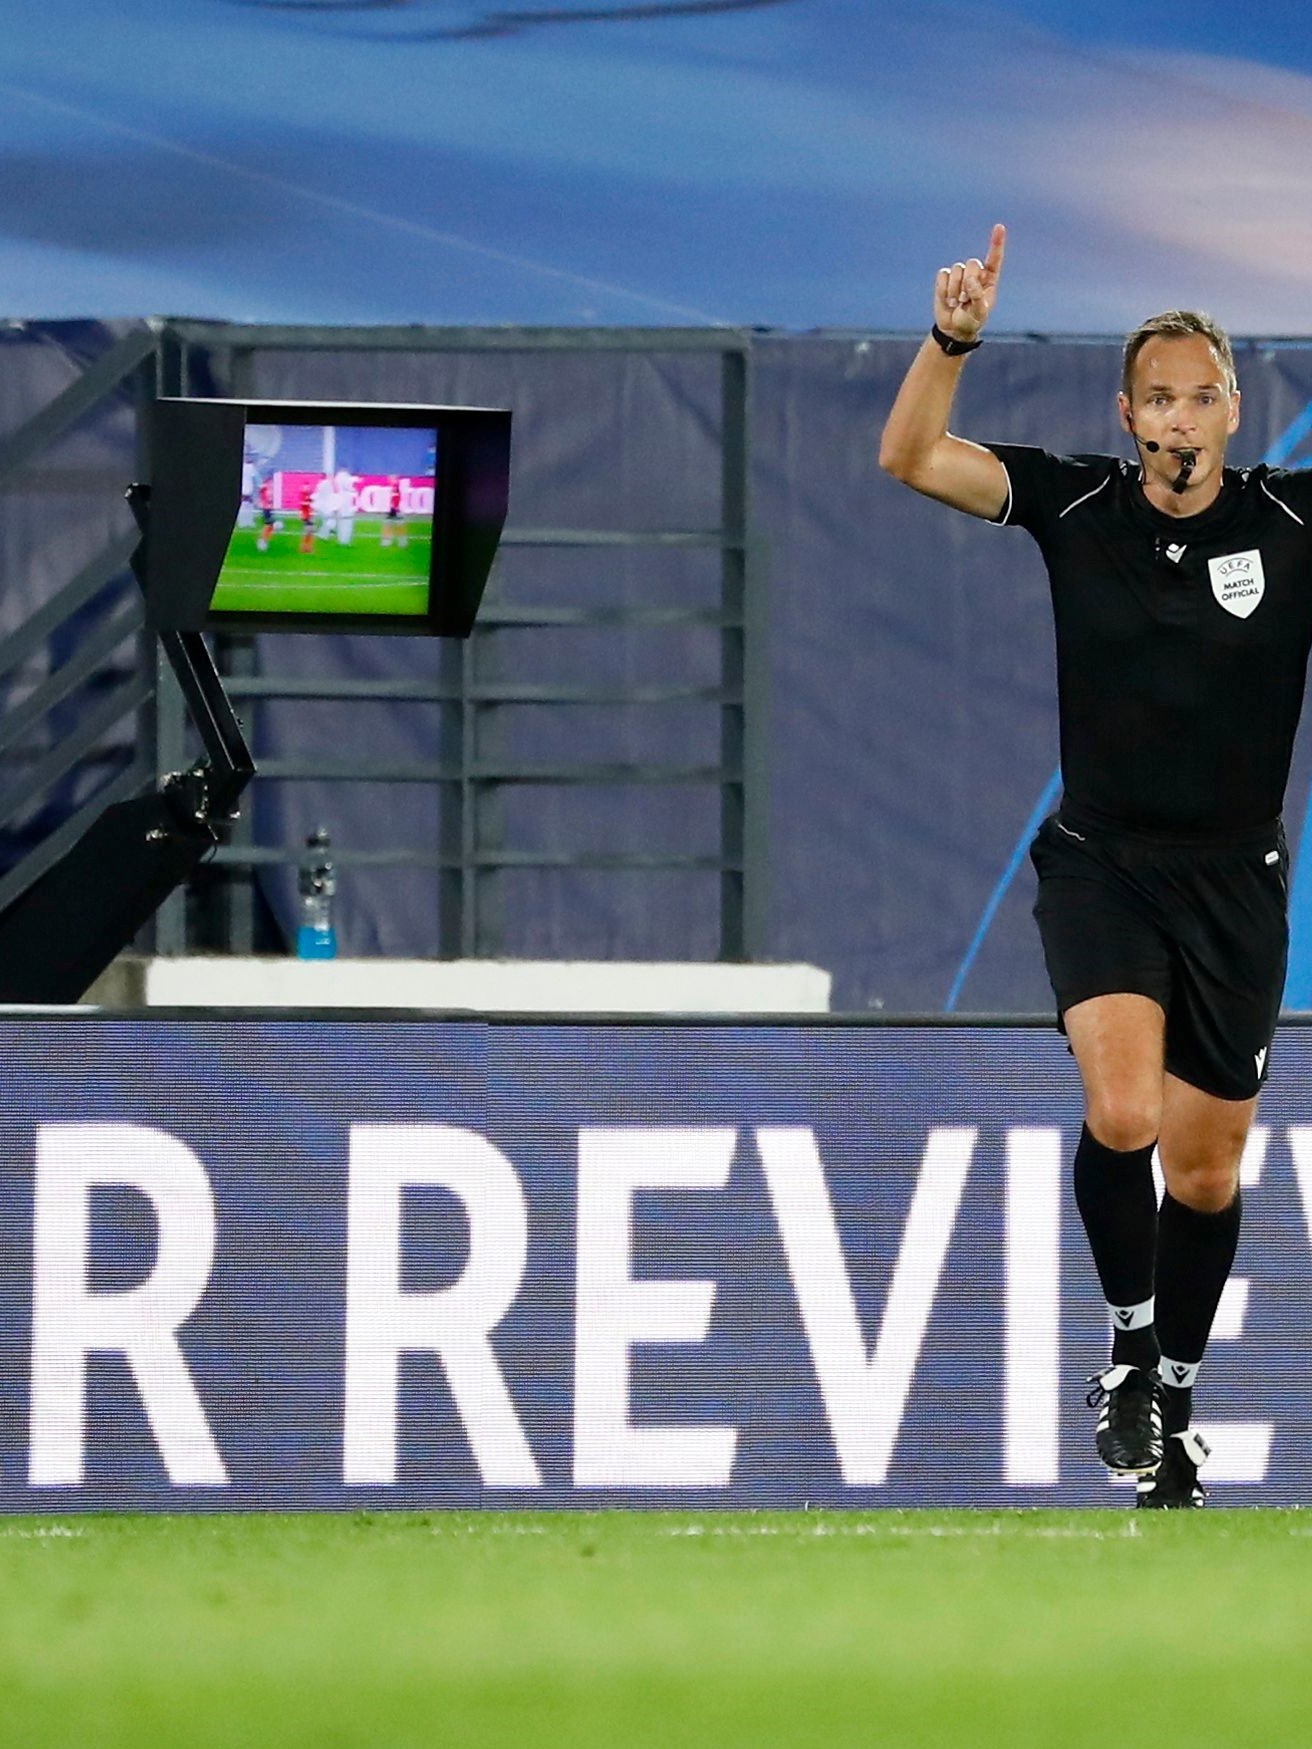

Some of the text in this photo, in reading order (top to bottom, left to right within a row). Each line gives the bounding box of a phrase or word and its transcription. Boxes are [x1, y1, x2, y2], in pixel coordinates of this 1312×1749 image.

[1219, 560, 1250, 575] UEFA
[1223, 578, 1254, 590] MATCH
[1221, 588, 1259, 601] OFFICIAL
[28, 1123, 231, 1487] R
